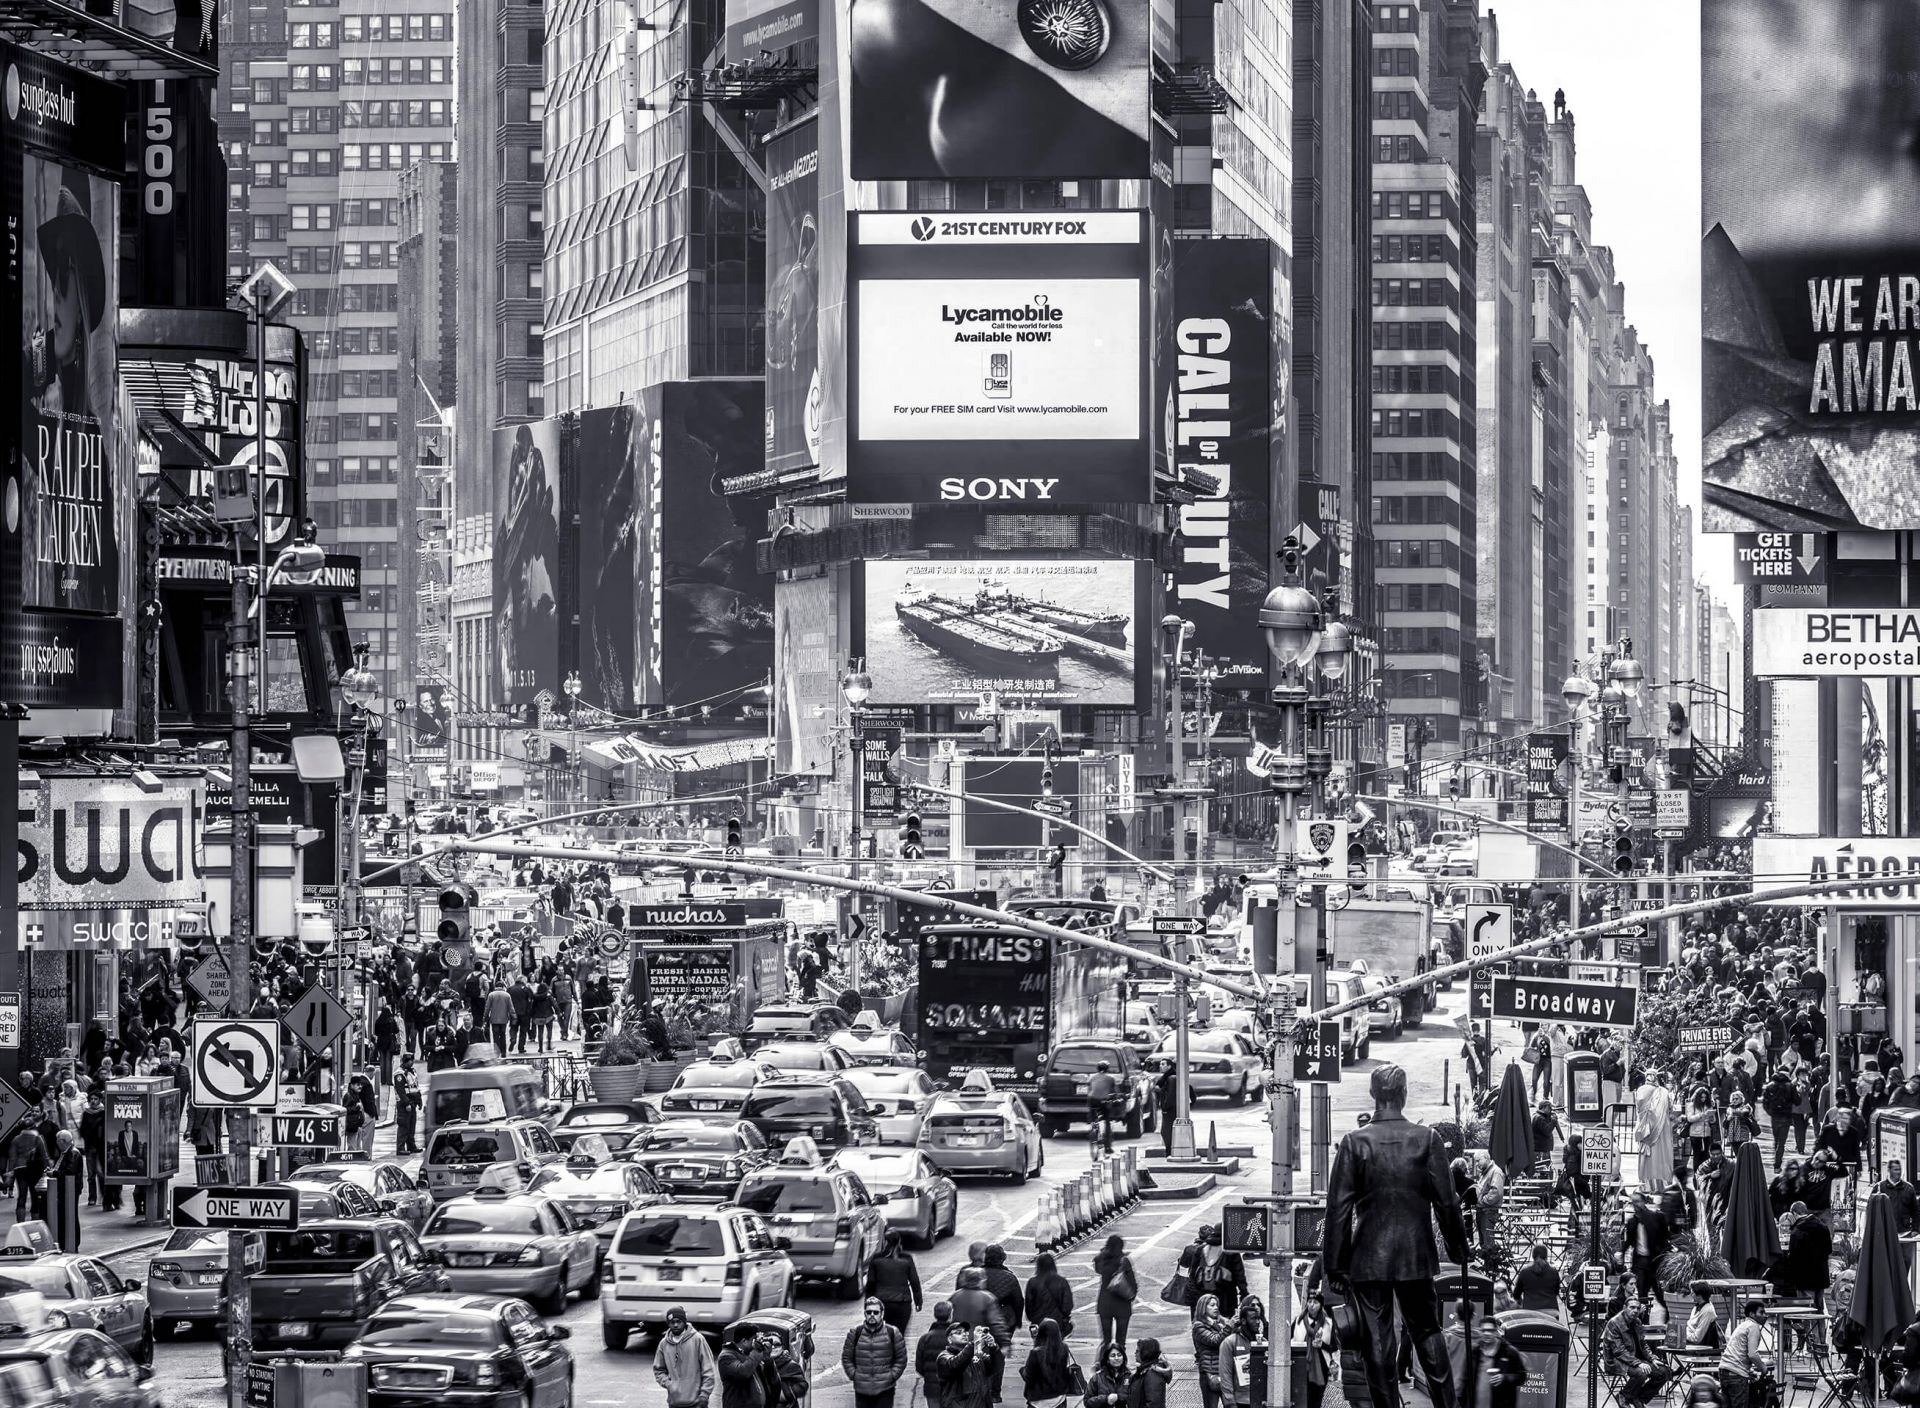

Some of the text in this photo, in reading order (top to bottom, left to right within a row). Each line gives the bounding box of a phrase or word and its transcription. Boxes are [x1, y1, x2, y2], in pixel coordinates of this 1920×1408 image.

[743, 12, 803, 47] www.lycamobile.com
[21, 78, 75, 126] sunglass hut
[941, 221, 1087, 235] 21ST CENTURY FOX
[1808, 276, 1864, 332] WE
[942, 304, 1063, 325] Lycamobile
[954, 332, 1052, 342] Available NOW!
[1177, 318, 1231, 446] CALL
[1809, 340, 1920, 414] AMA
[894, 405, 1108, 415] For your FREE SIM card Visit www.lycamobile.com
[1200, 440, 1218, 459] OF
[37, 424, 102, 502] RALPH
[940, 477, 1059, 500] SONY
[1318, 488, 1337, 521] CALL
[853, 505, 910, 517] SHERWOOD
[37, 498, 102, 567] LAUREN
[1758, 533, 1792, 548] GET
[1739, 548, 1793, 561] TICKETS
[158, 557, 226, 580] EYEWITNESS
[1753, 562, 1793, 576] HERE
[1768, 584, 1822, 595] COMPANY
[21, 637, 74, 684] hut sunglass
[1223, 664, 1264, 675] ACTIVISION
[860, 718, 905, 728] SHERWOOD
[865, 740, 887, 751] SOME
[865, 750, 890, 761] WALLS
[1530, 747, 1554, 759] SOME
[1630, 748, 1643, 758] ME
[1530, 758, 1557, 770] WALLS
[1629, 758, 1646, 767] ALLS
[865, 771, 884, 782] TALK
[1530, 771, 1546, 780] CAN
[1627, 776, 1640, 786] ALK
[1738, 773, 1765, 785] Hard
[1122, 758, 1132, 811] NYPD
[1530, 781, 1550, 793] TALK
[248, 796, 290, 806] EMELLI
[1633, 901, 1656, 910] W 45
[646, 905, 727, 923] nuchas
[73, 921, 160, 942] swatch
[177, 922, 198, 934] NYPD
[1160, 922, 1199, 930] ONE WAY
[947, 936, 1033, 962] TIMES
[650, 976, 728, 985] EMPANADAS
[30, 984, 69, 1000] swatc
[208, 989, 229, 997] AHEAD
[1515, 988, 1616, 1021] Broadway
[926, 1003, 1046, 1030] SQUARE
[1680, 1027, 1732, 1042] PRIVATE EYES
[1325, 1045, 1337, 1057] St
[114, 1110, 142, 1119] MAN
[276, 1119, 334, 1144] W 46 ST
[1586, 1151, 1609, 1160] WALK
[197, 1158, 219, 1184] TIMES
[1587, 1162, 1607, 1170] BIKE
[206, 1200, 286, 1218] ONE WAY
[7, 1247, 24, 1255] 3J15
[256, 1369, 274, 1381] STANDING
[252, 1381, 271, 1393] ANYTIME
